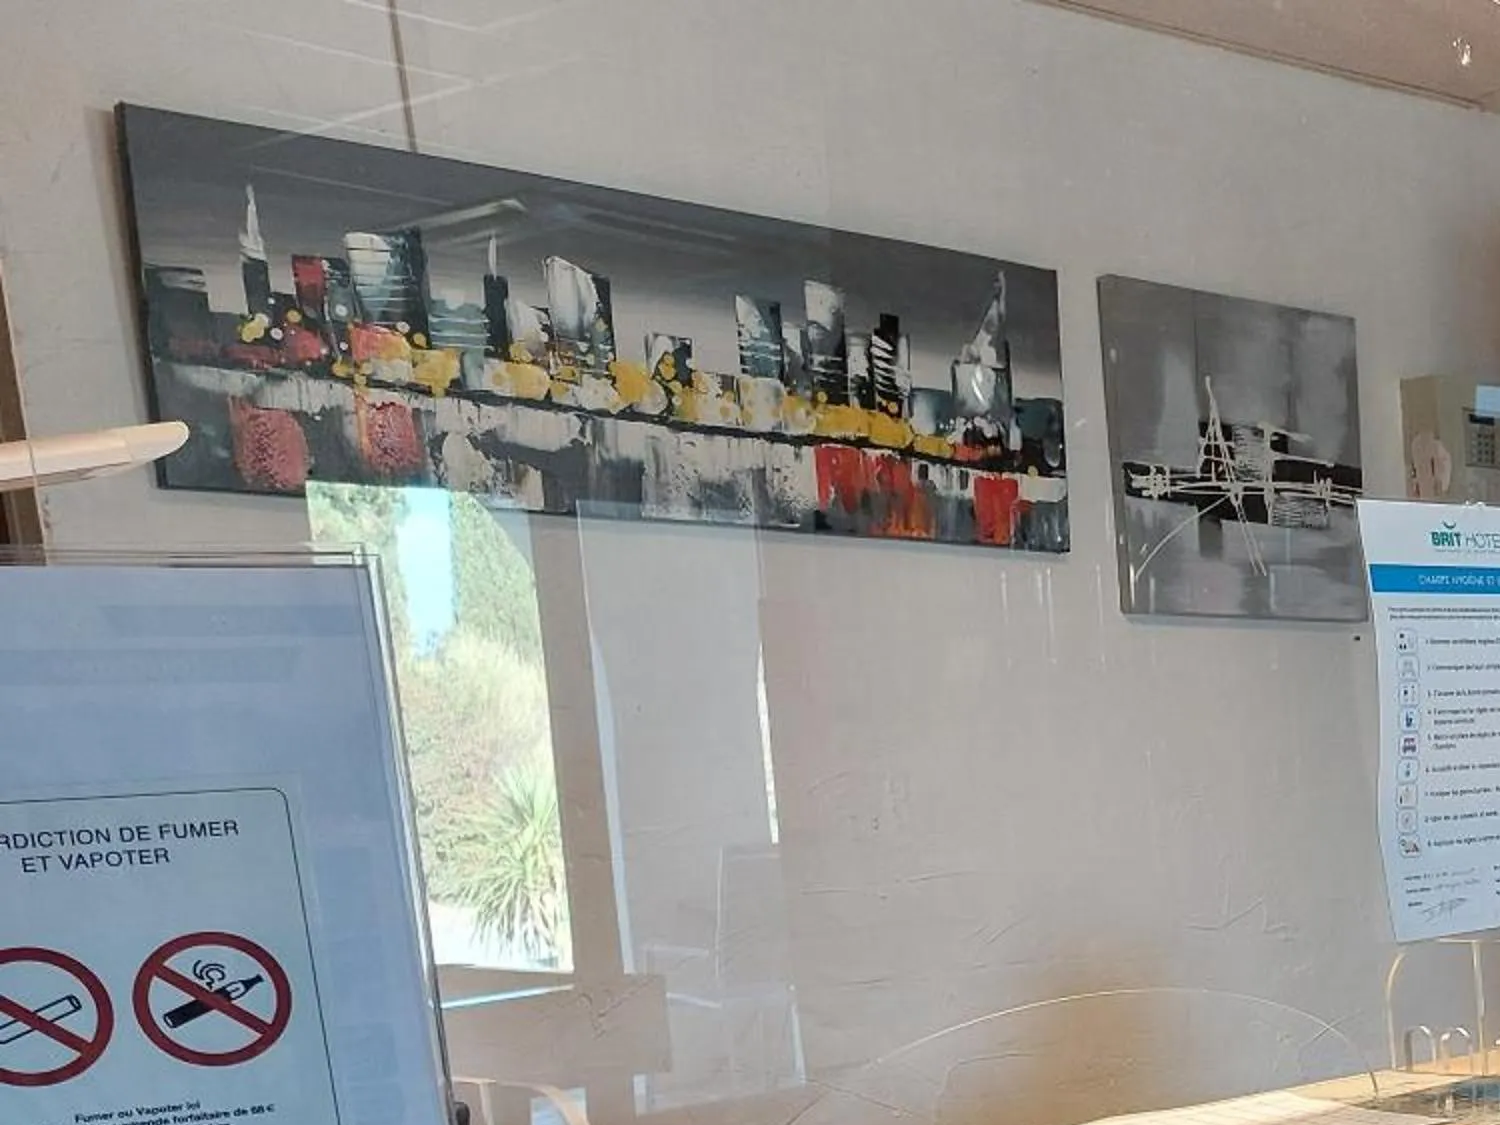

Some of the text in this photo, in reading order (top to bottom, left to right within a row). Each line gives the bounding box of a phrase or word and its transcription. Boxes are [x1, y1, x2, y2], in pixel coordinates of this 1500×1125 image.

[1430, 531, 1461, 547] BRIT
[119, 825, 151, 843] DE
[159, 820, 239, 841] FUMER
[21, 847, 169, 873] ET VAPOTER
[75, 1112, 113, 1123] Fumer
[118, 1110, 132, 1118] ou
[135, 1104, 183, 1116] Vapoter
[173, 1110, 230, 1125] forfaitaire
[233, 1108, 248, 1117] de
